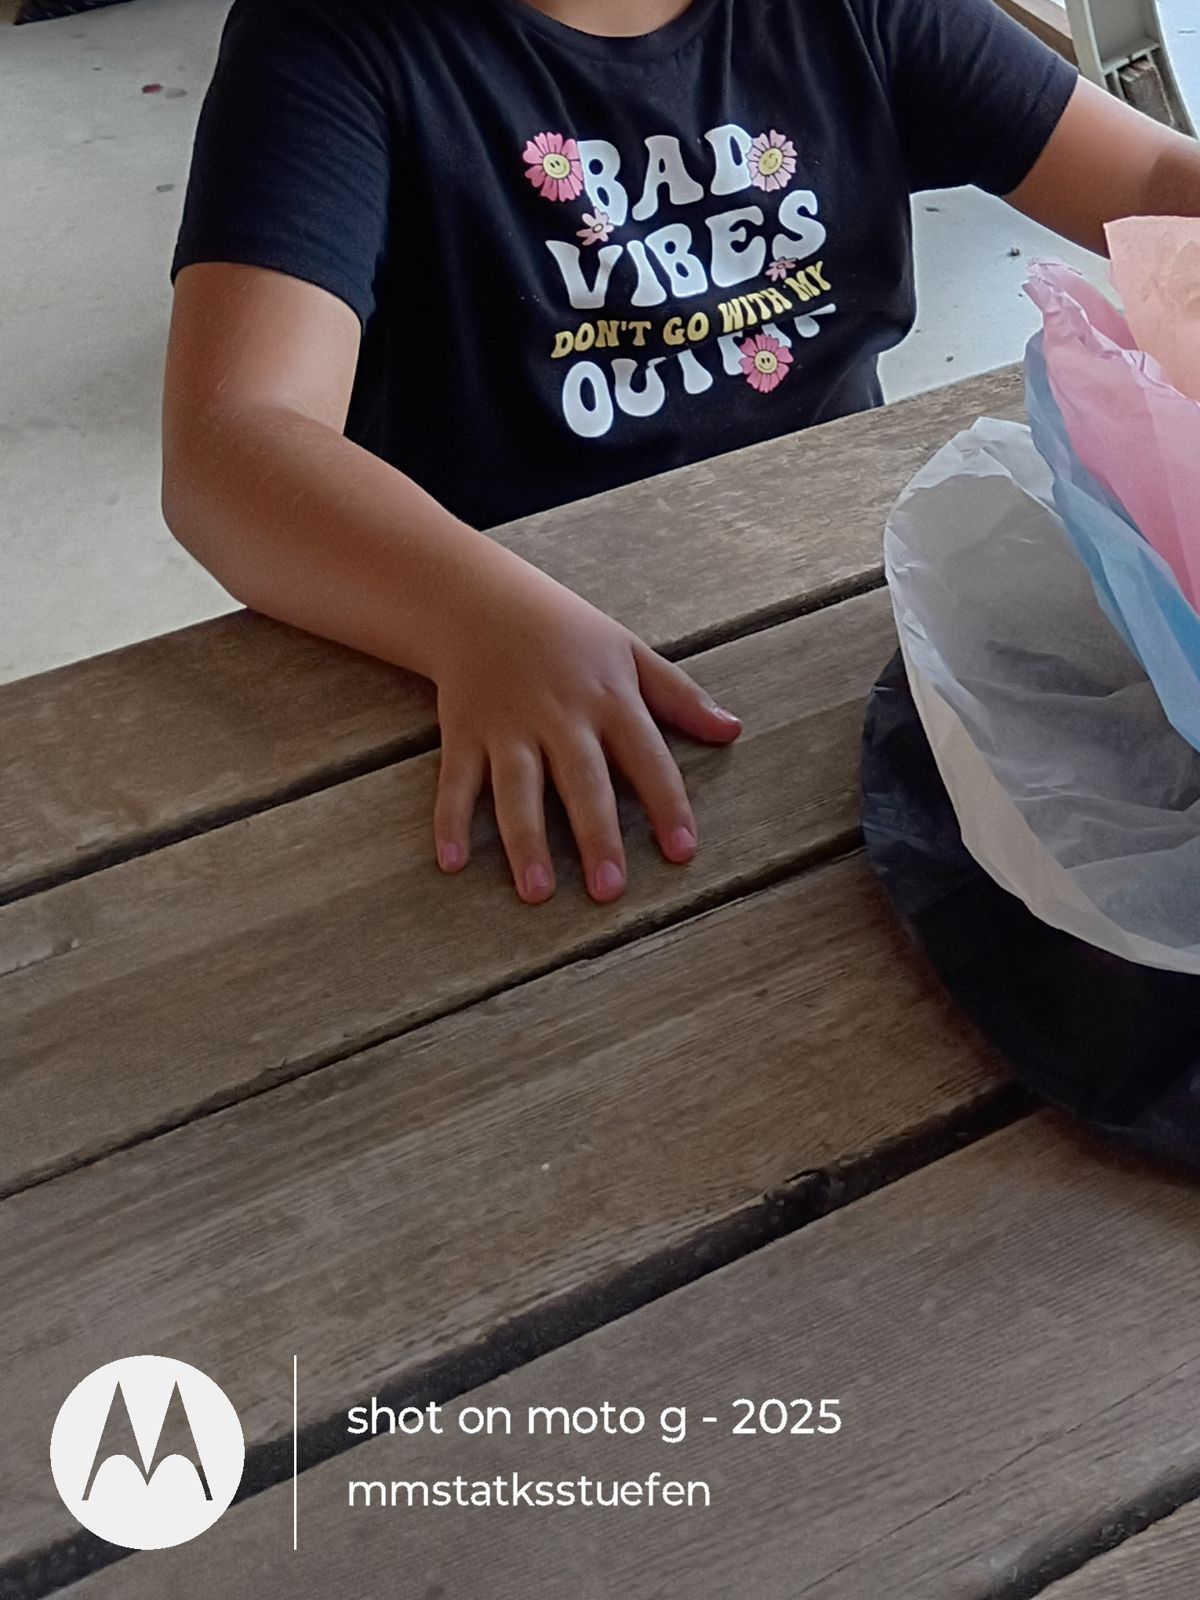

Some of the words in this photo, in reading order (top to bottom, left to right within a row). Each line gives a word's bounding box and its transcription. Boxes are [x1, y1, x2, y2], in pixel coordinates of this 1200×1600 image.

[577, 124, 752, 226] BAD
[545, 190, 827, 310] VIBES
[550, 319, 652, 358] DON'T
[662, 311, 710, 346] GO
[717, 287, 793, 333] WITH
[784, 260, 832, 302] MY
